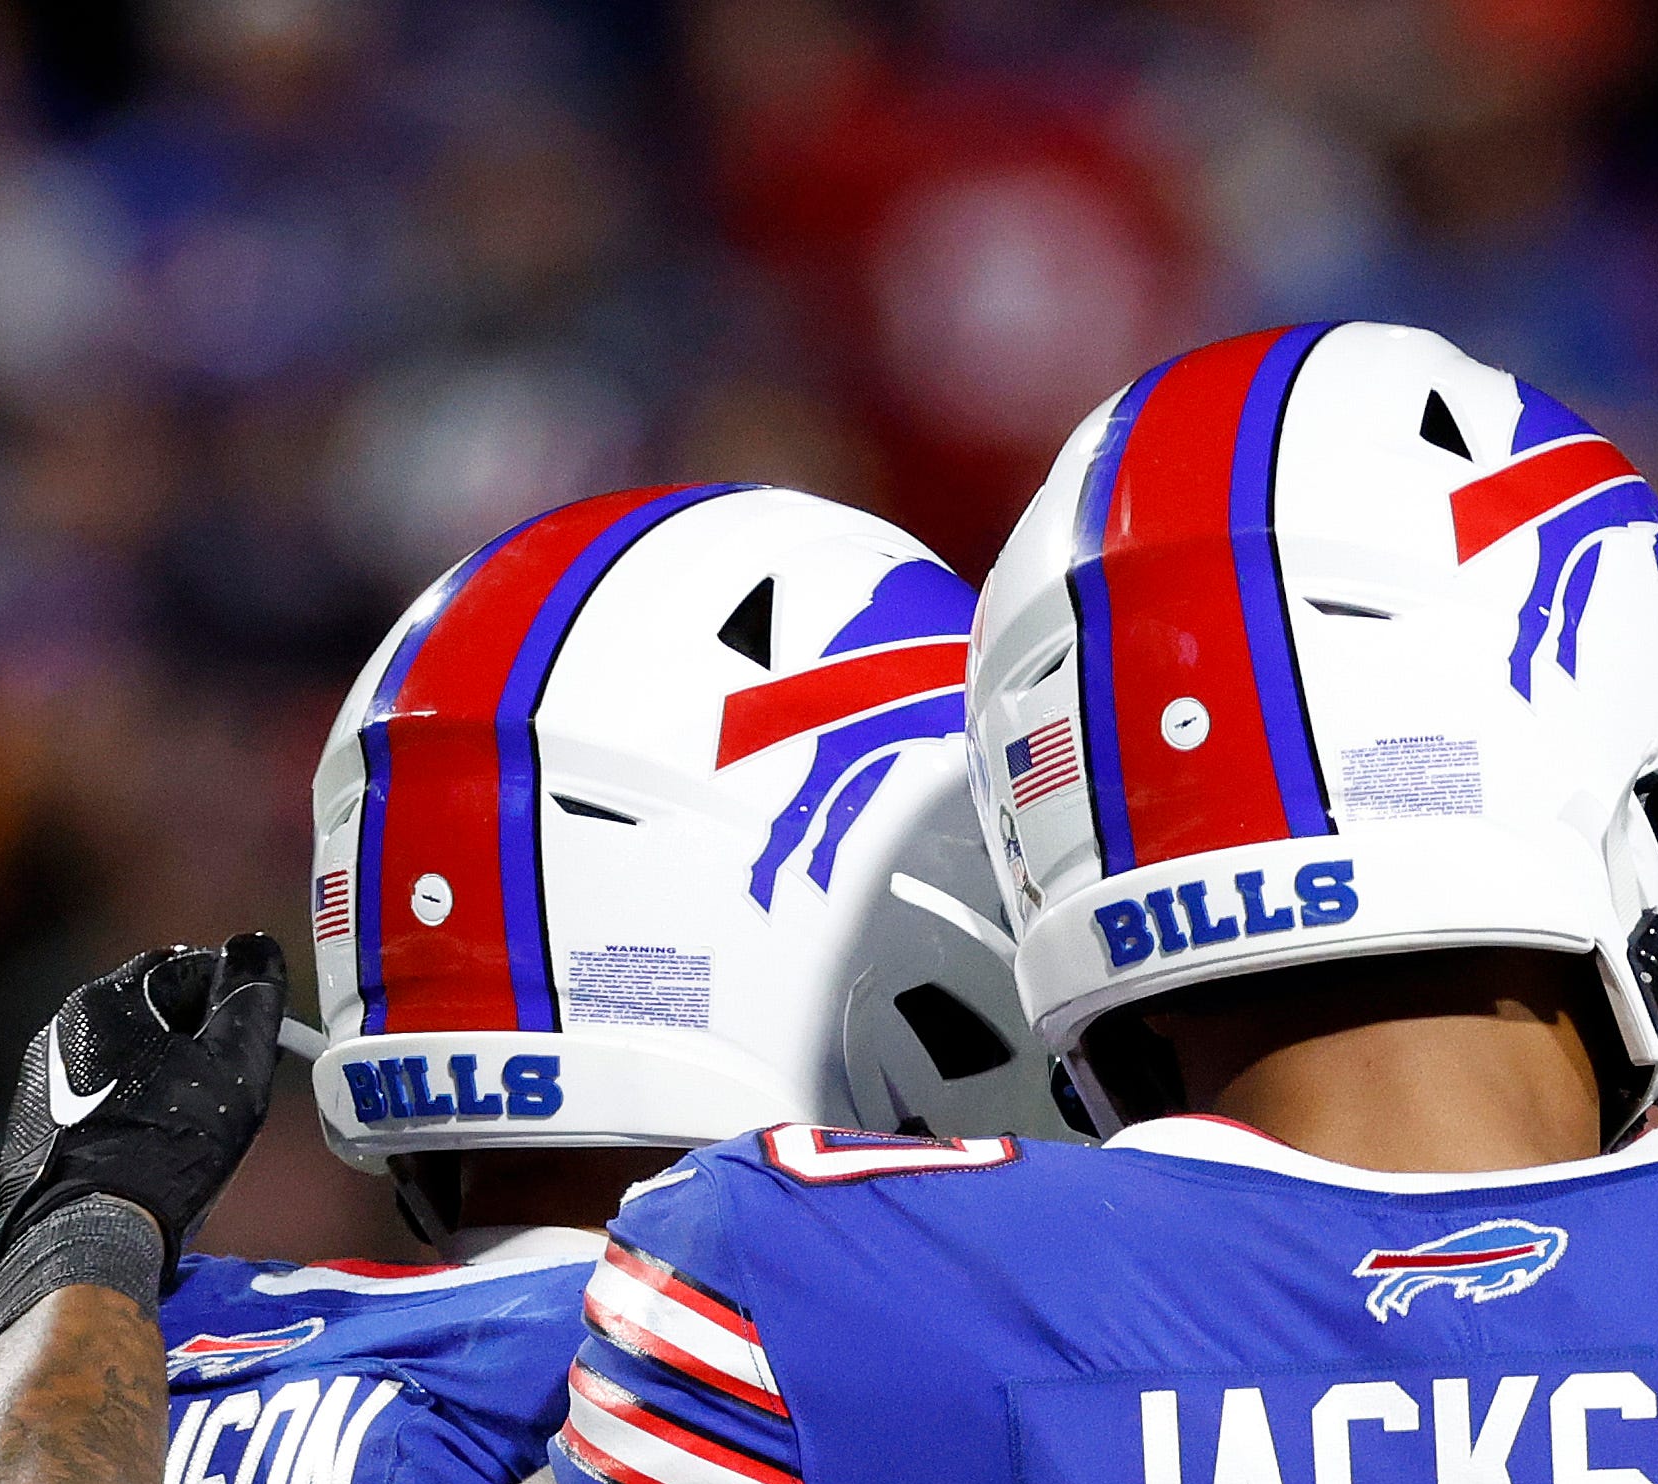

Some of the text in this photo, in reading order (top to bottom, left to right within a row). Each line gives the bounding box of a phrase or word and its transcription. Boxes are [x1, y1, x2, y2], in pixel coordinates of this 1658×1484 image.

[1375, 735, 1445, 746] WARNING
[1094, 859, 1359, 968] BILLS
[605, 945, 677, 954] WARNING
[342, 1054, 564, 1123] BILLS
